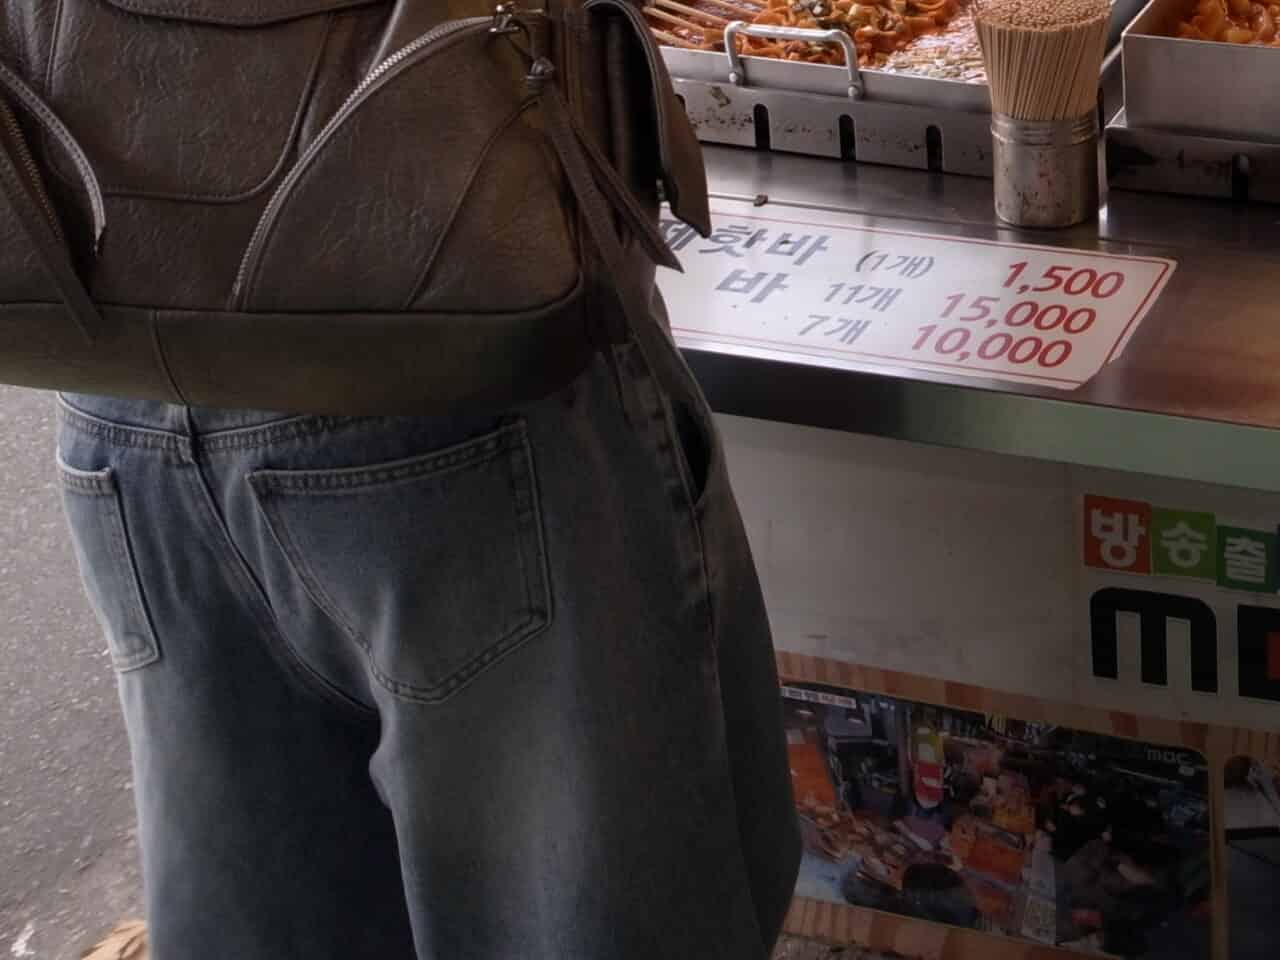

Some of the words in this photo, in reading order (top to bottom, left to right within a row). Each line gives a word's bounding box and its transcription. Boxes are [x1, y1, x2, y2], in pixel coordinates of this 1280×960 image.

[855, 249, 935, 280] (1개)
[1001, 261, 1126, 299] 1,500
[824, 282, 904, 312] 11개
[940, 292, 1097, 335] 15,000
[798, 314, 873, 345] 7개
[911, 324, 1073, 369] 10,000
